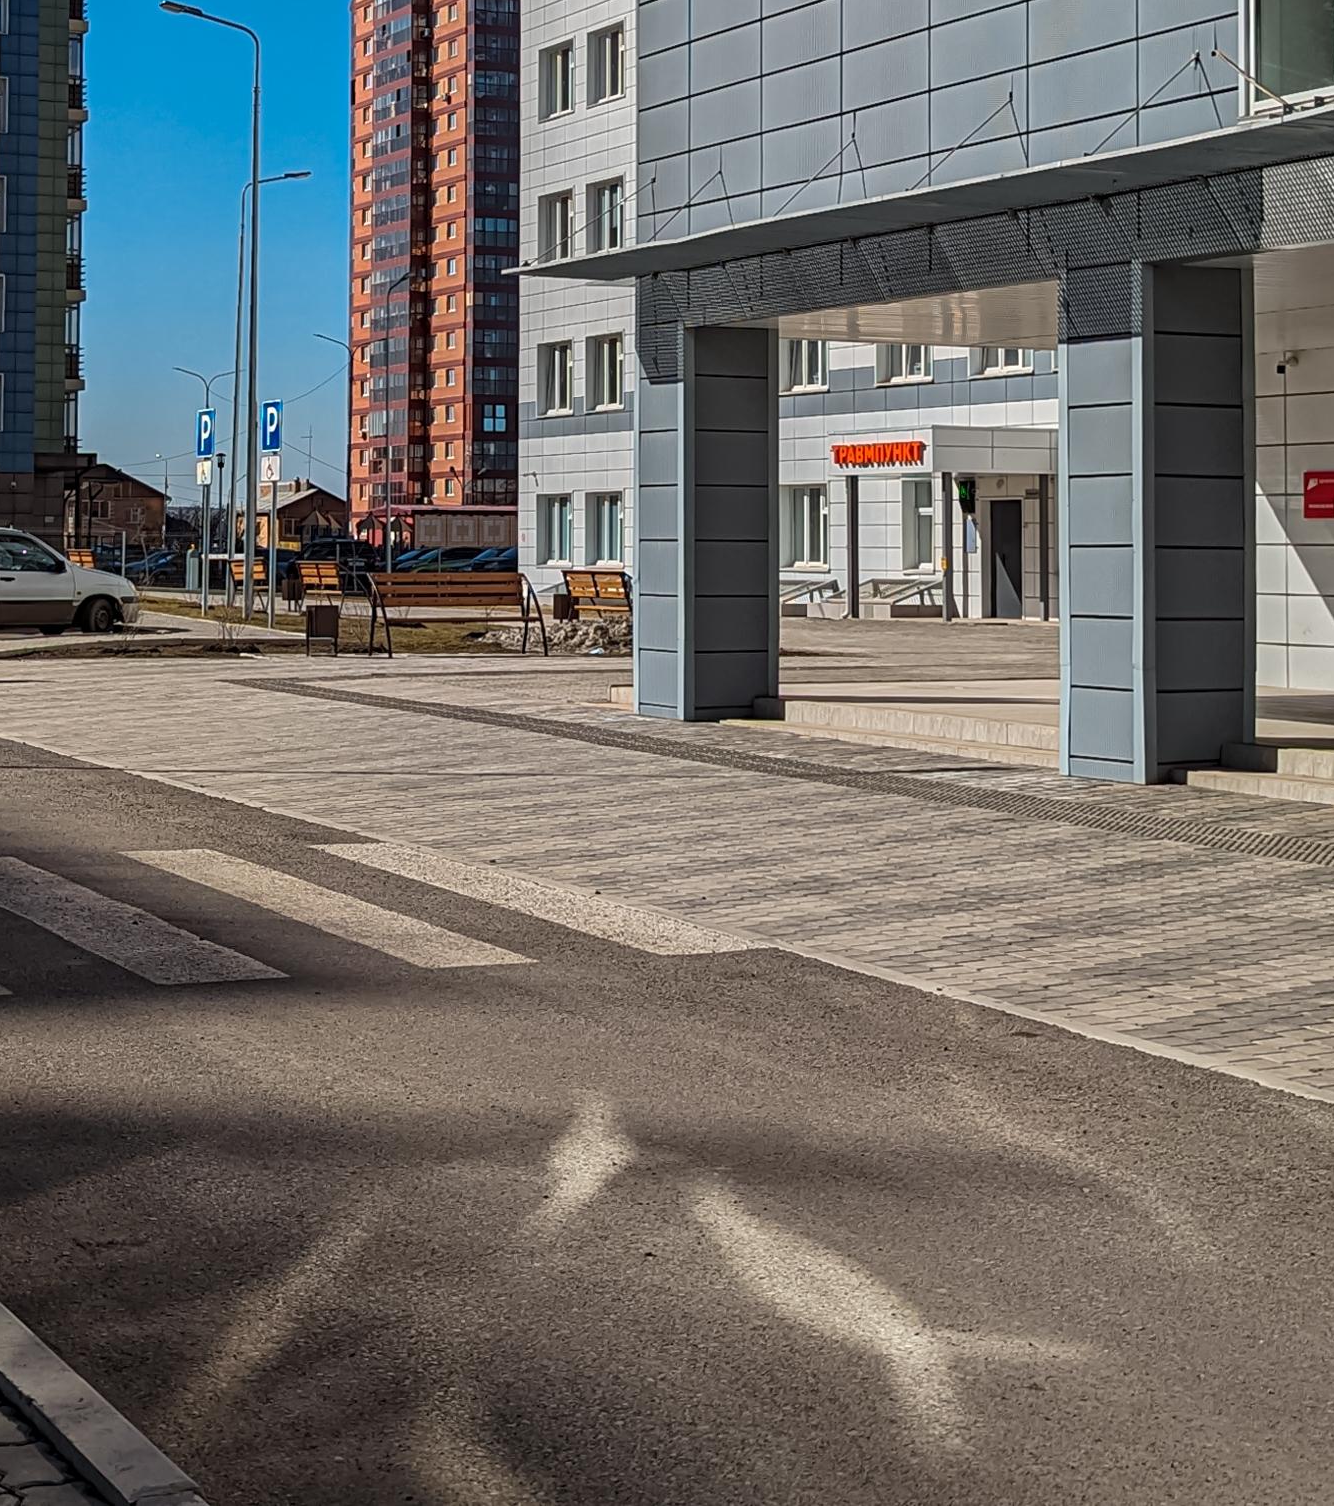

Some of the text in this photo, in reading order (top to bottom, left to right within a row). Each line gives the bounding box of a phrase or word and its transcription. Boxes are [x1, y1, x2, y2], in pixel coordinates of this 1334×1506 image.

[201, 414, 212, 452] P
[267, 406, 278, 446] P
[830, 441, 924, 465] ТРАВМПУНКТ
